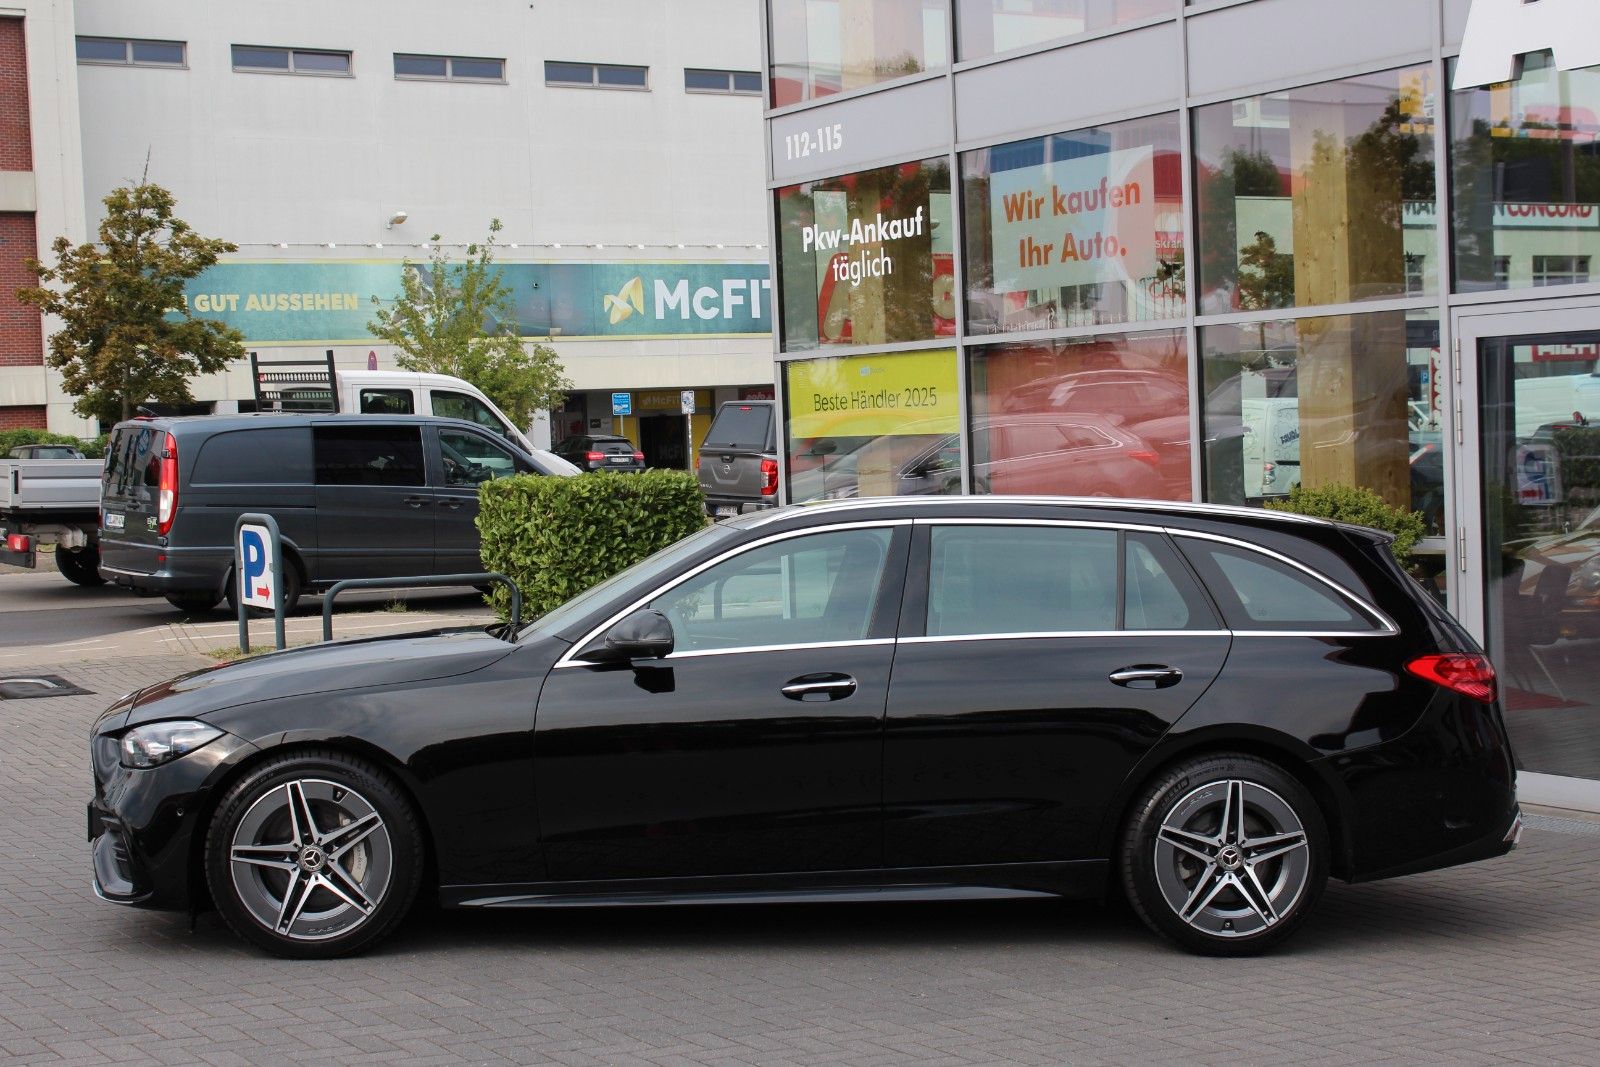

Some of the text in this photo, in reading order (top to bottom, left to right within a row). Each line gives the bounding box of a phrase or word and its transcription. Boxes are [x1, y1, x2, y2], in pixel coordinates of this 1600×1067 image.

[785, 124, 843, 160] 112-115
[1004, 176, 1142, 223] Wir kaufen
[802, 206, 923, 252] Pkw-Ankauf
[832, 247, 892, 287] täglich
[1019, 231, 1127, 268] Ihr Auto.
[194, 294, 240, 312] GUT
[244, 293, 358, 311] AUSSEHEN
[814, 387, 937, 411] Beste Händler 2025
[242, 530, 267, 599] P
